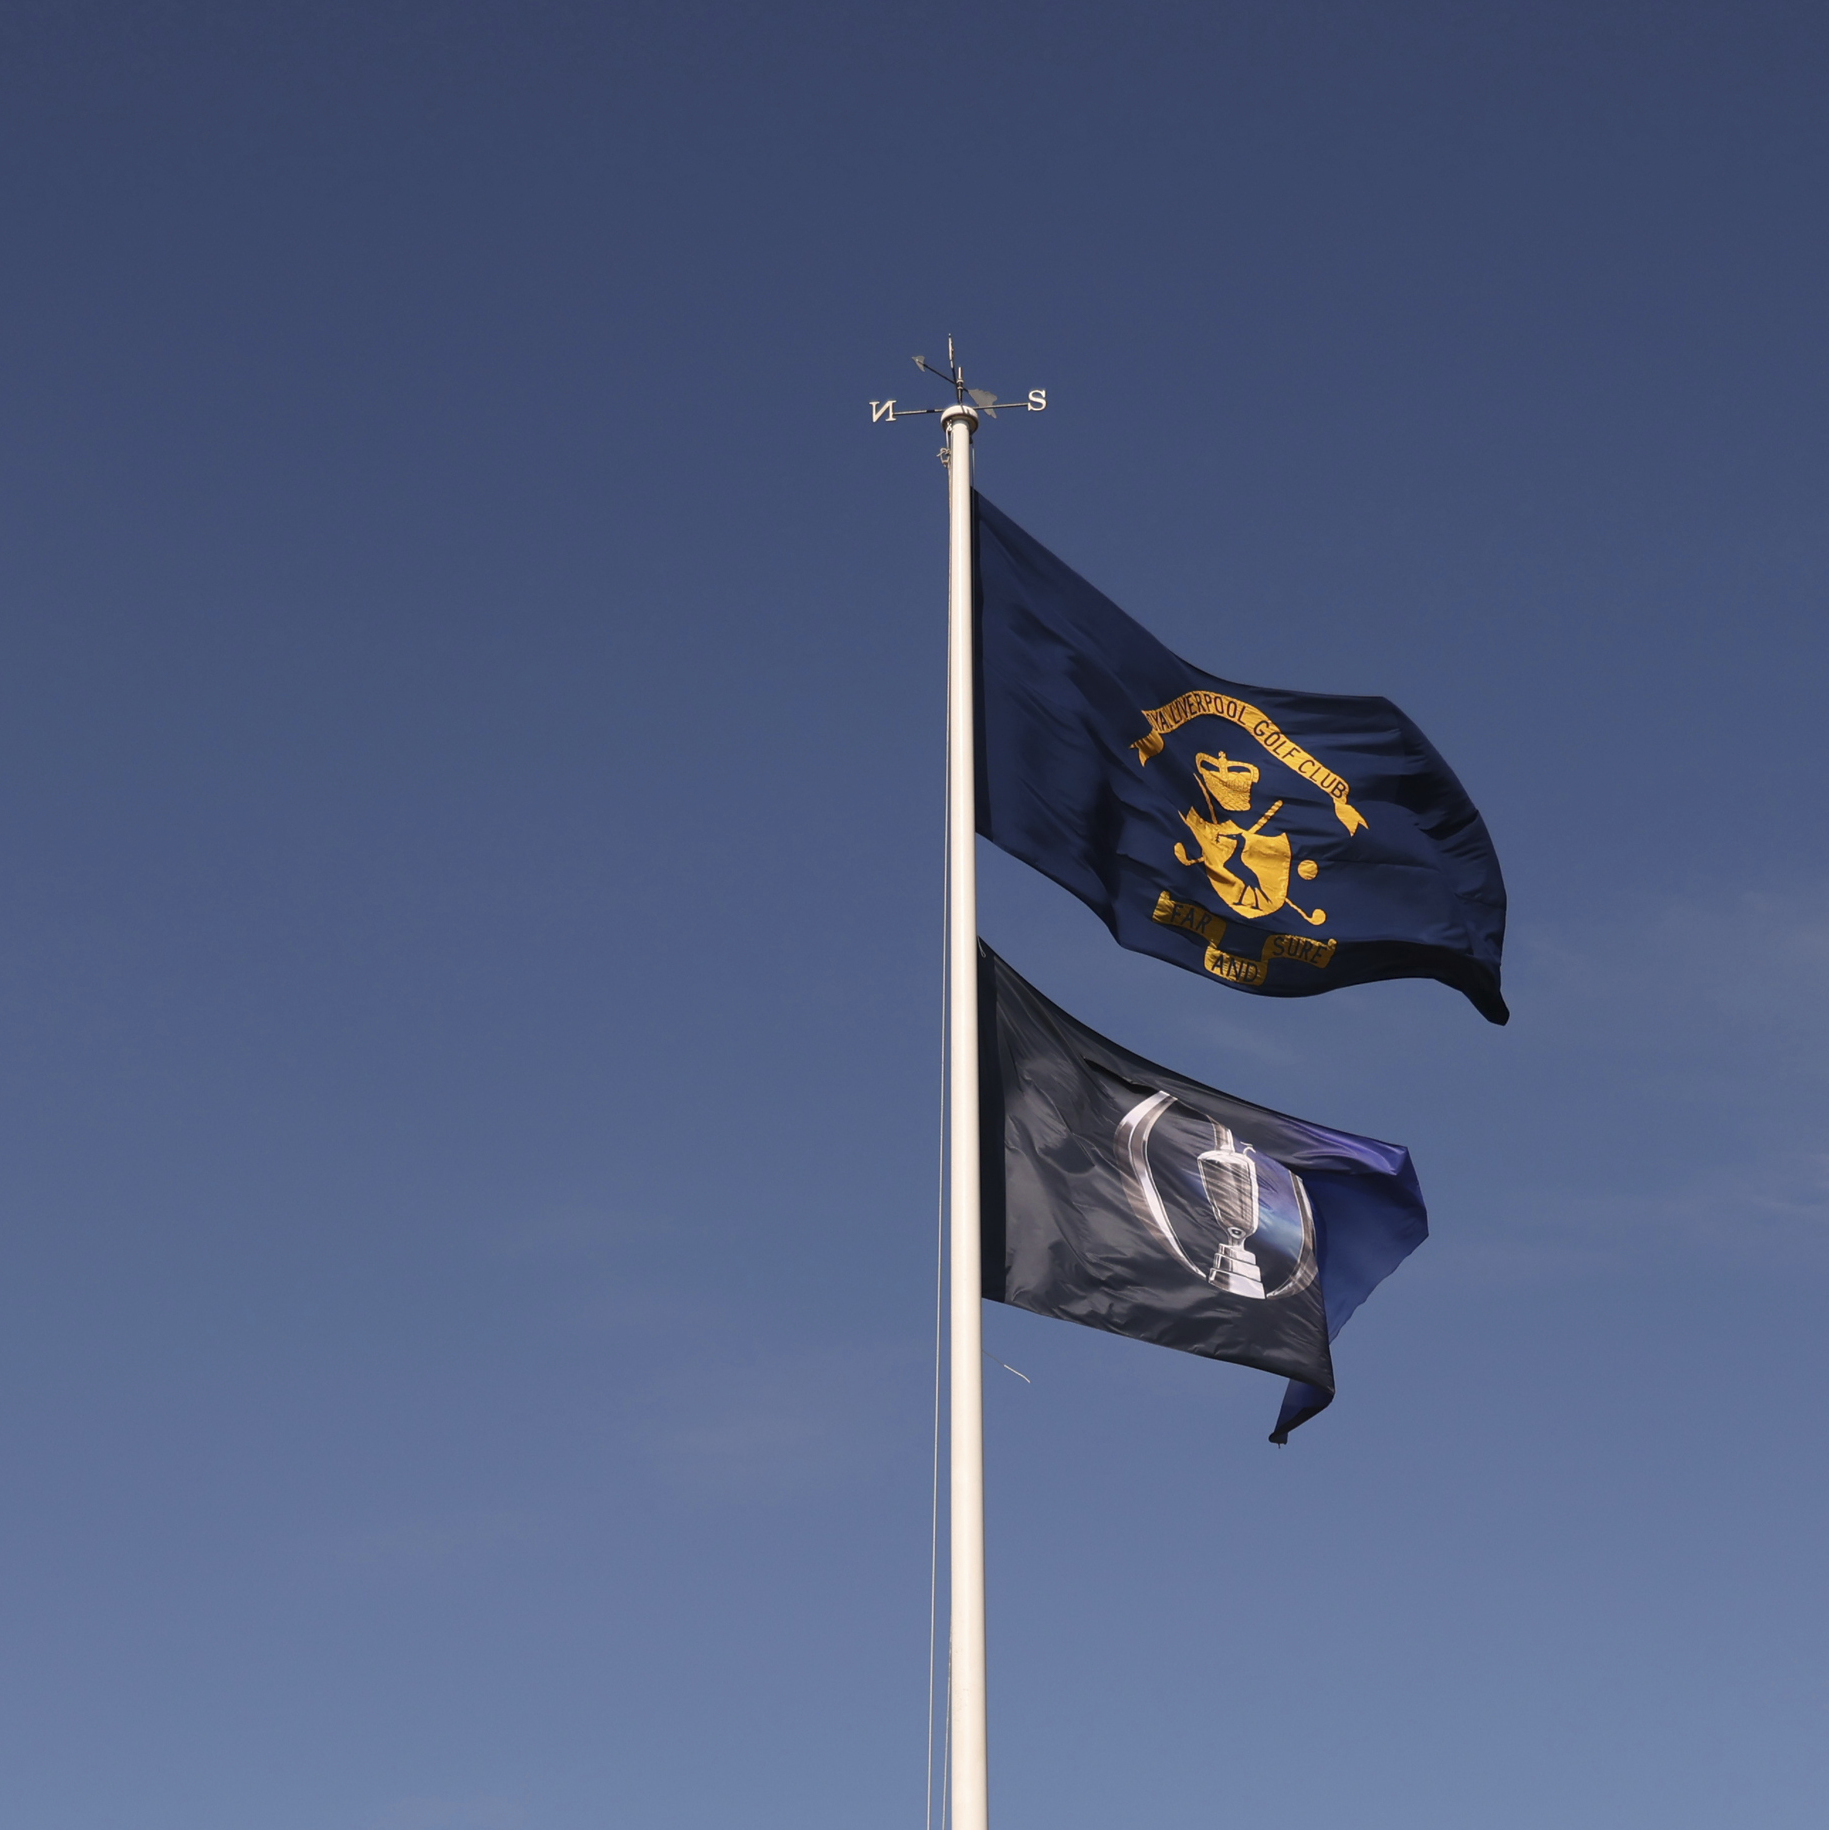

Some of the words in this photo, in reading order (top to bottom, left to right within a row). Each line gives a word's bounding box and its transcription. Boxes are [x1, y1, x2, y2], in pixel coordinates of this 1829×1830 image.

[1027, 389, 1047, 411] S
[1170, 693, 1247, 726] LIVERPOOL
[1253, 720, 1301, 760] GOLF
[1298, 760, 1347, 799] CLUB
[1170, 904, 1213, 934] FAR
[1212, 955, 1259, 983] AND
[1272, 936, 1324, 964] SURE
